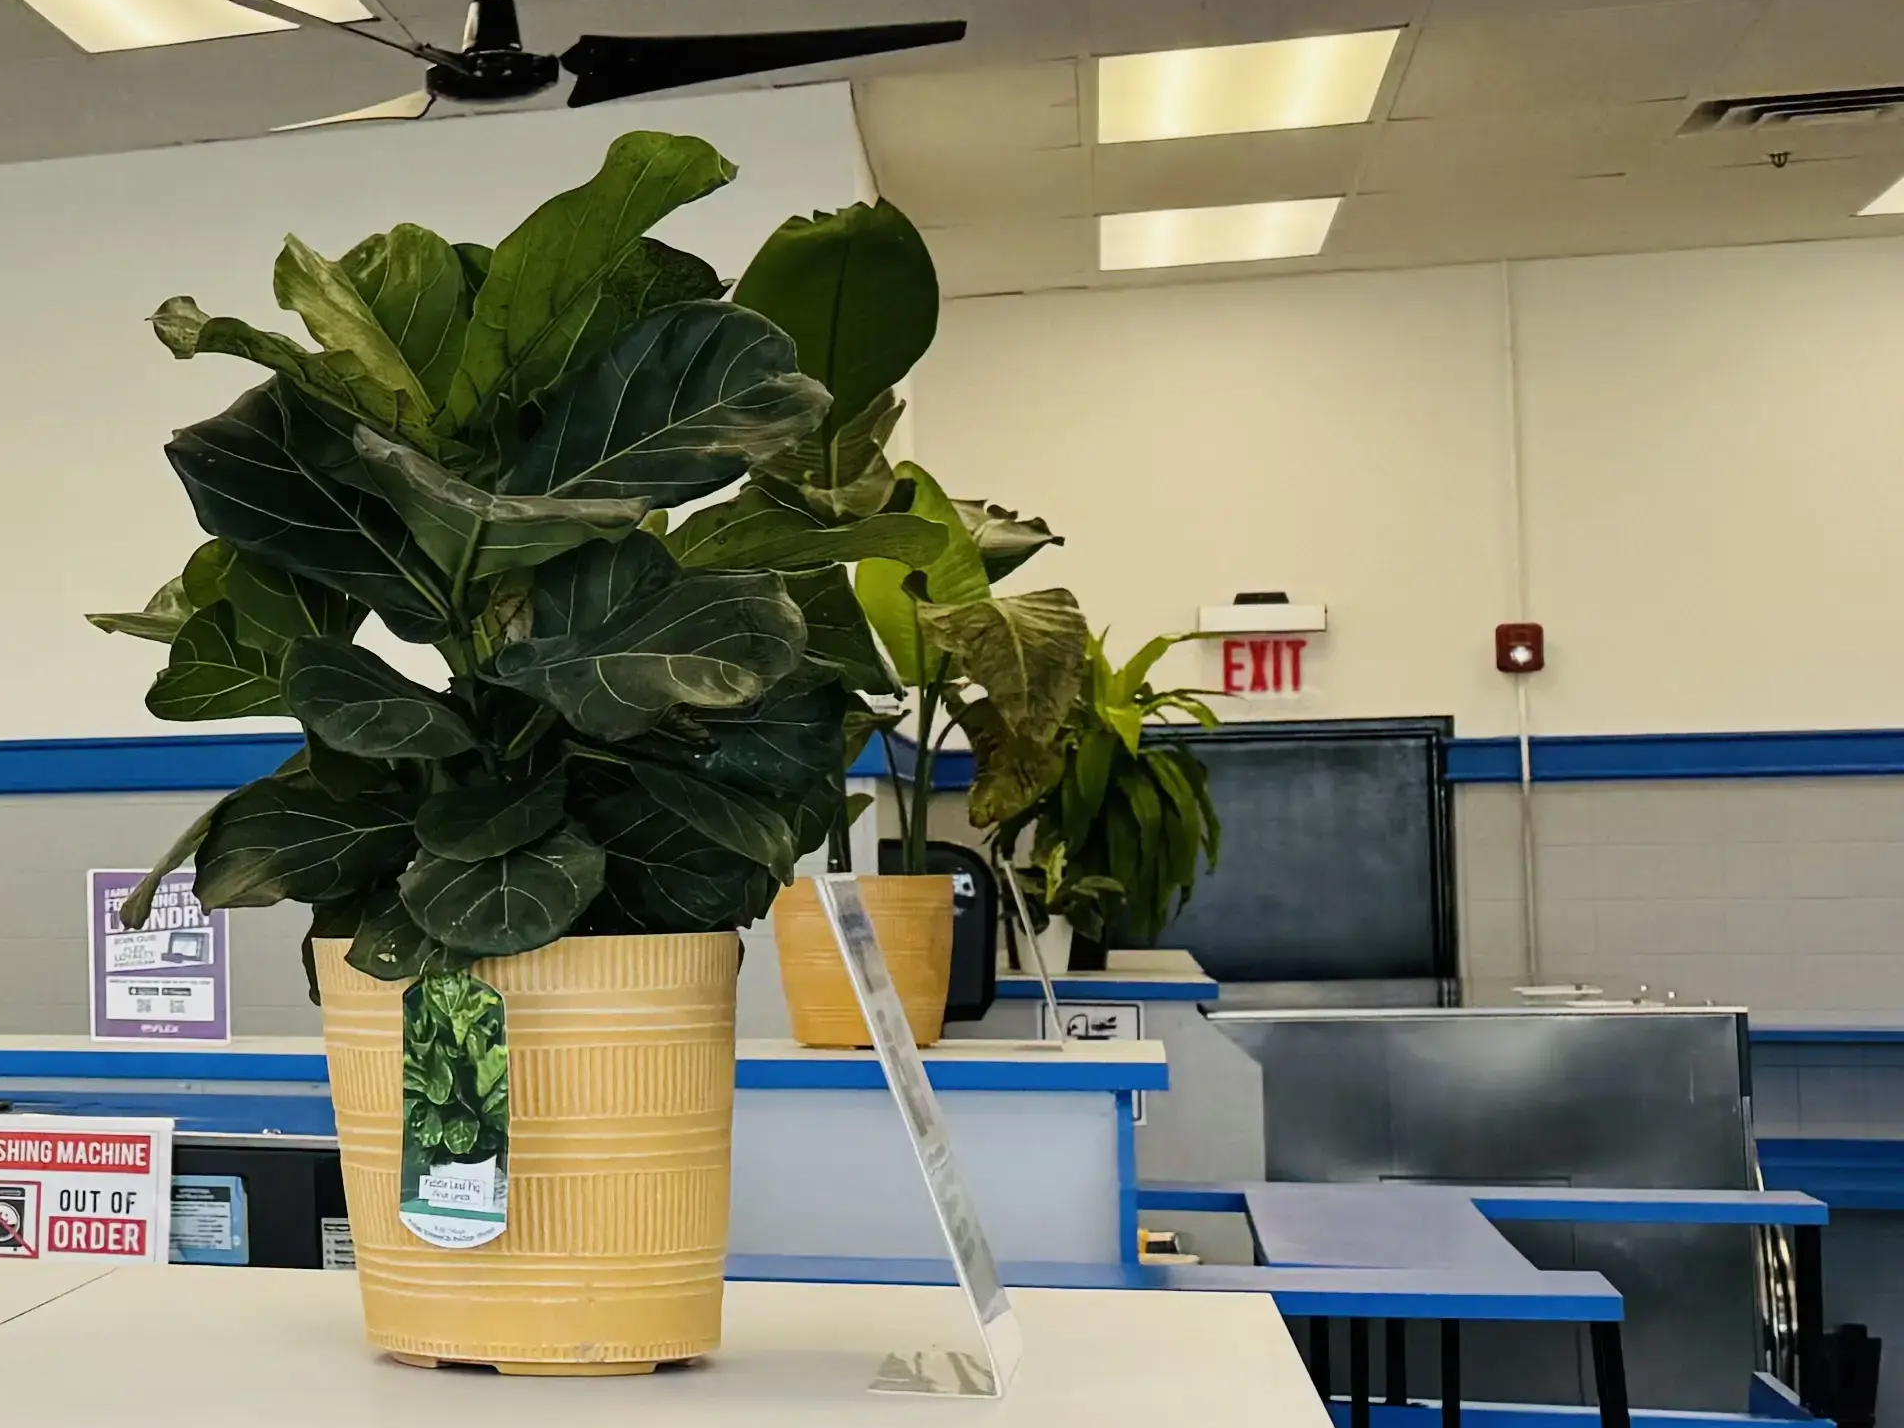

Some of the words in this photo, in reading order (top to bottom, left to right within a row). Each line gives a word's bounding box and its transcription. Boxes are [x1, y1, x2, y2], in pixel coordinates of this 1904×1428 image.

[1221, 639, 1308, 693] EXIT
[56, 1140, 148, 1167] MACHINE
[59, 1188, 102, 1213] OUT
[110, 1190, 138, 1215] OF
[52, 1219, 141, 1253] ORDER
